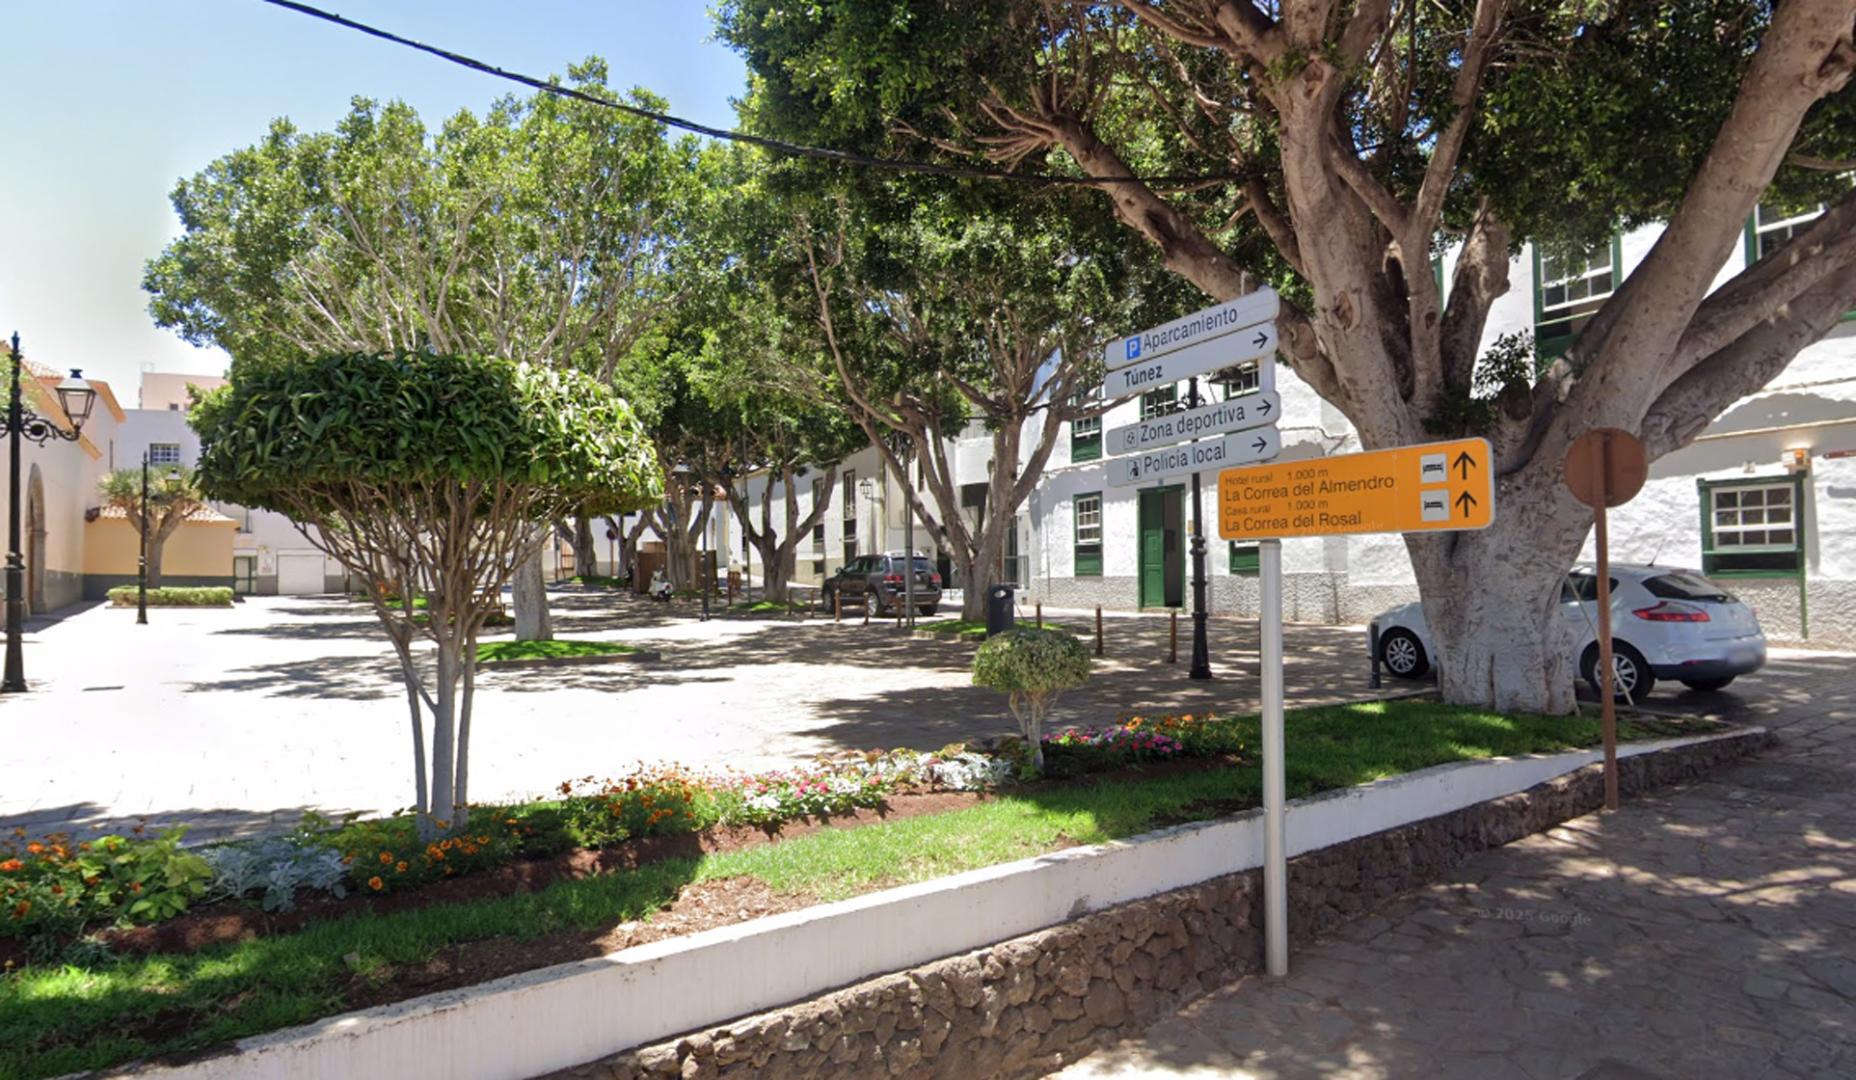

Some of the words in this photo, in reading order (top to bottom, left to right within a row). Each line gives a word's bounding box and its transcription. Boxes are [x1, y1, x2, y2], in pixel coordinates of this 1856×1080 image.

[1143, 307, 1238, 351] Aparcamiento
[1124, 365, 1163, 388] Túnez
[1141, 425, 1173, 443] Zona
[1177, 405, 1246, 437] deportiva
[1144, 450, 1188, 474] Policía
[1192, 441, 1227, 467] local
[1225, 476, 1248, 486] Hotel
[1251, 472, 1273, 483] rural
[1286, 469, 1316, 481] 1.000
[1317, 469, 1329, 478] m
[1225, 490, 1241, 502] La
[1243, 486, 1288, 501] Correa
[1292, 482, 1315, 497] del
[1318, 475, 1395, 494] Almendro
[1225, 506, 1248, 517] Casa
[1250, 503, 1272, 515] rural
[1286, 500, 1316, 511] 1.000
[1317, 499, 1329, 509] m
[1225, 520, 1241, 532] La
[1243, 517, 1288, 531] Correa
[1292, 513, 1315, 528] del
[1318, 510, 1362, 527] Rosal
